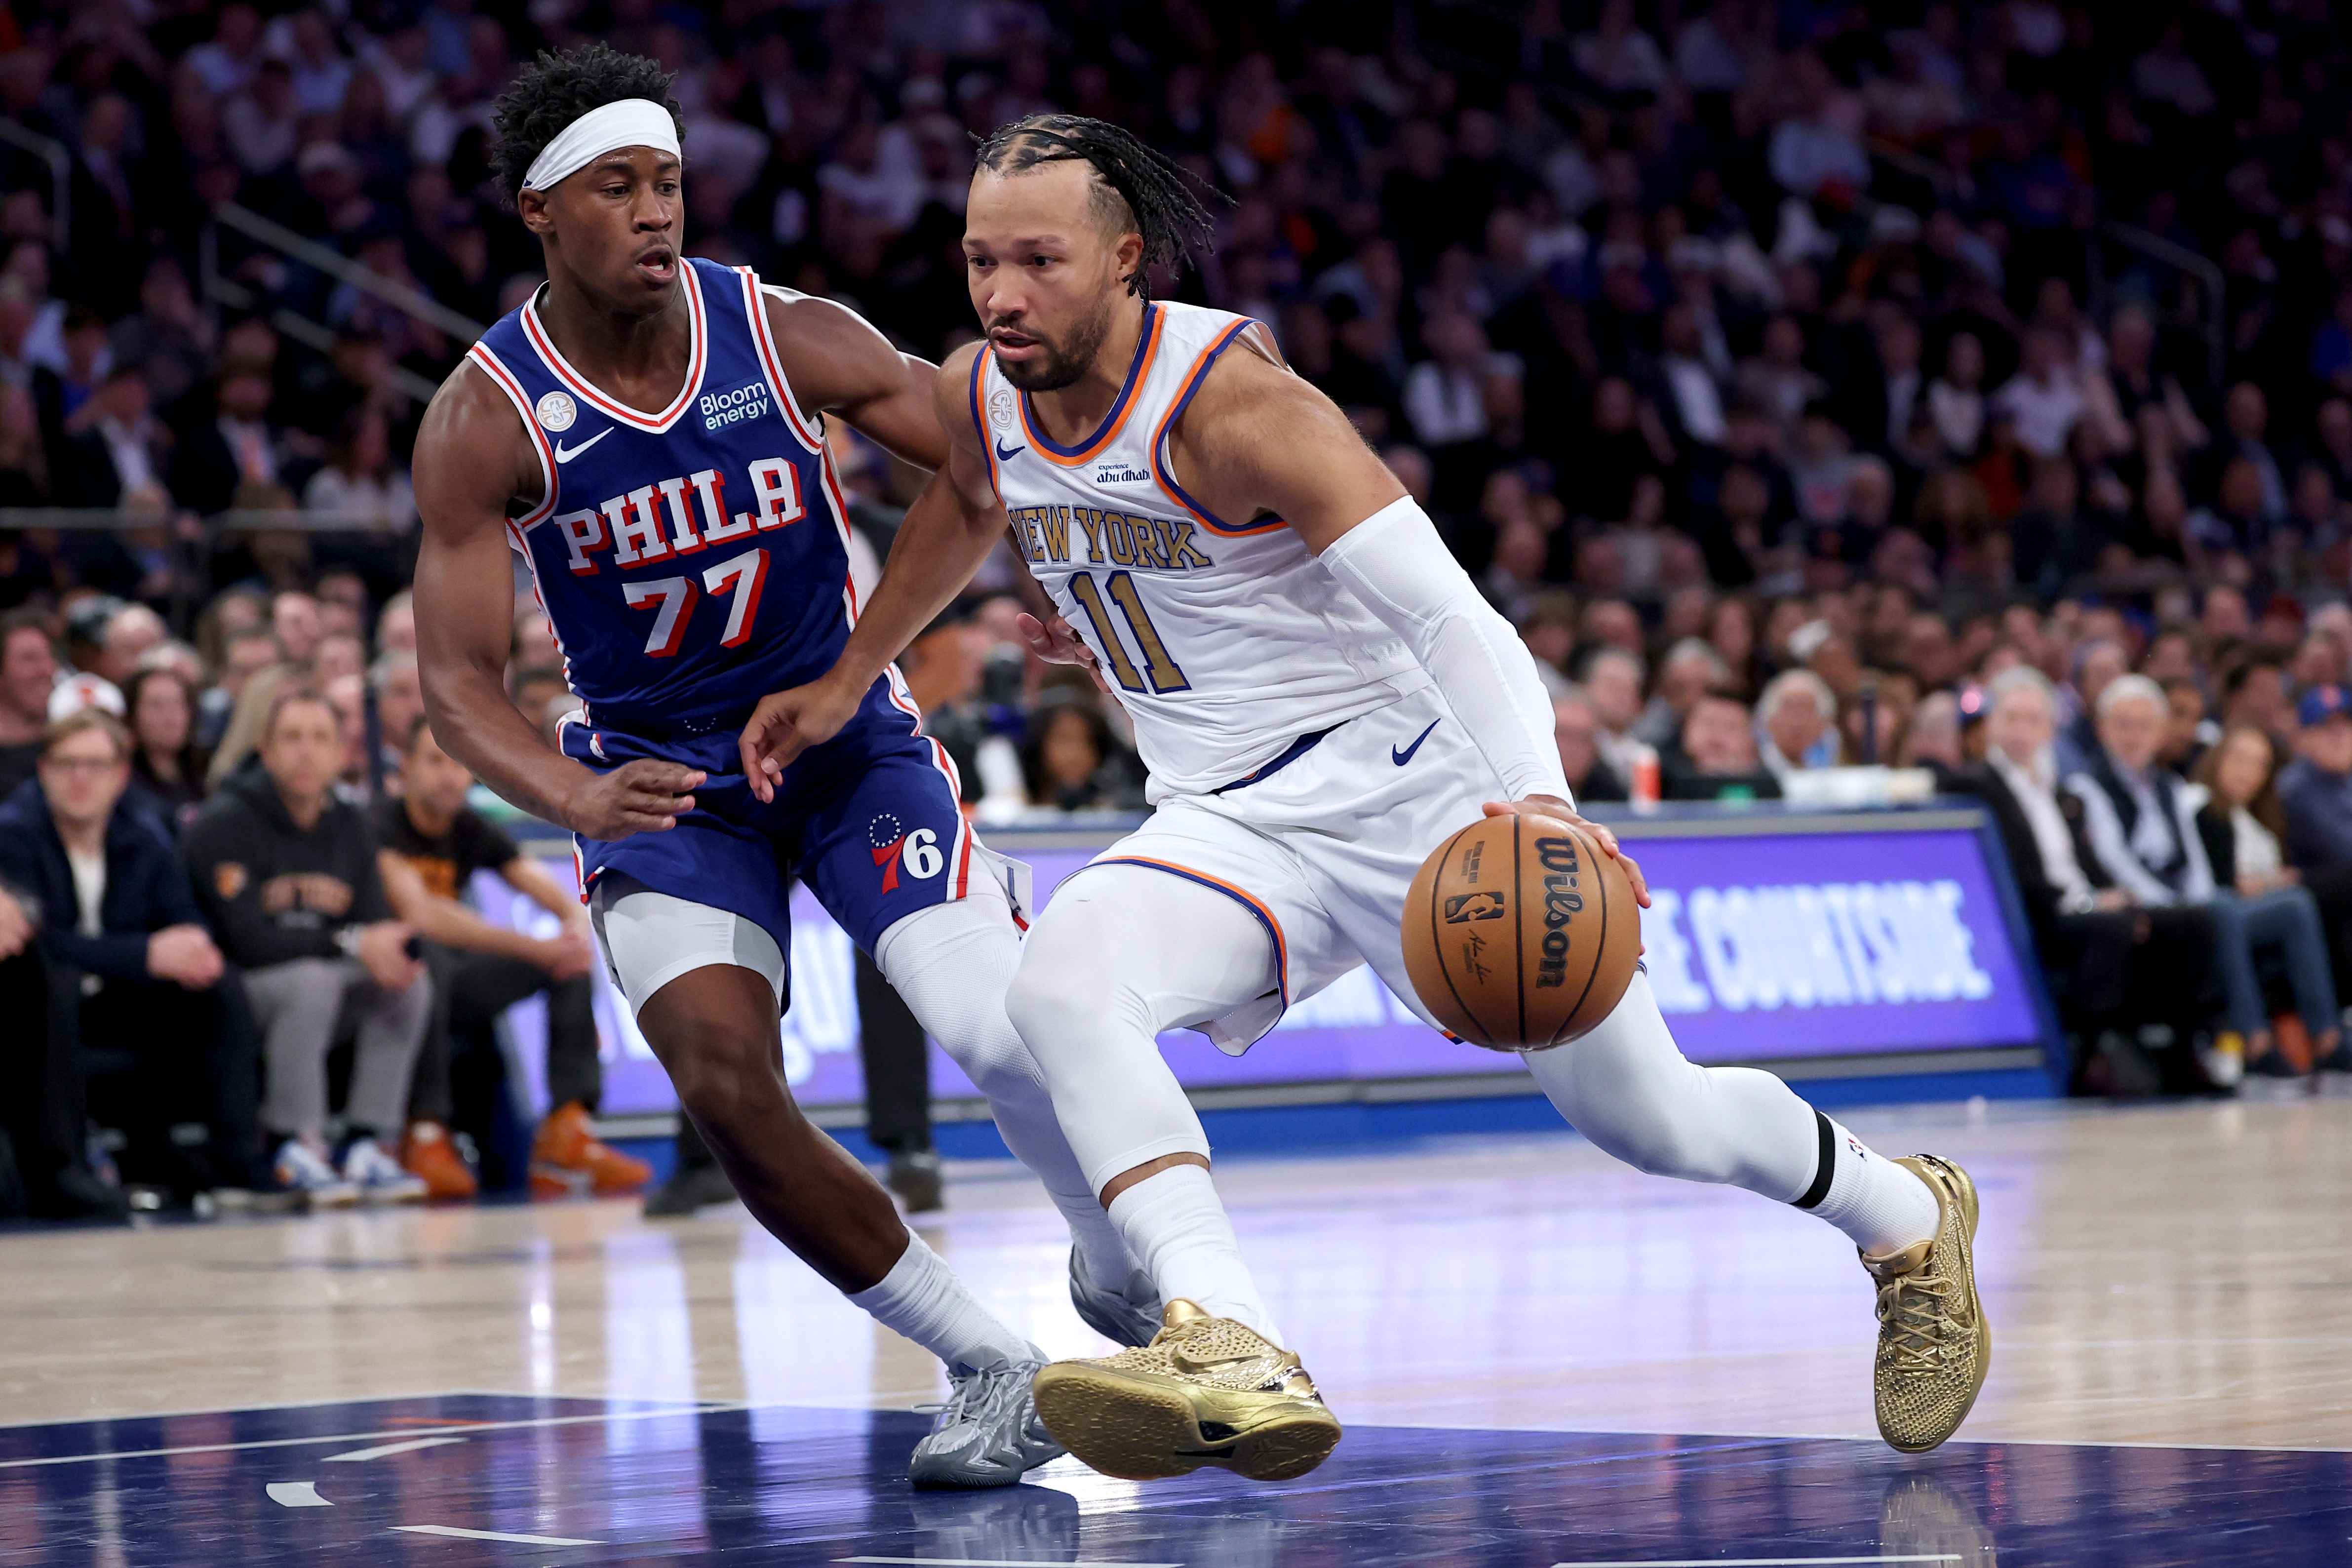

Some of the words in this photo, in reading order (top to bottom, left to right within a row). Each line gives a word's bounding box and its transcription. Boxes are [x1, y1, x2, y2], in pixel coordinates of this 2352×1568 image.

[700, 382, 766, 415] Bloom
[706, 397, 768, 430] energy
[1097, 471, 1119, 483] abu
[1121, 468, 1150, 481] dhabi
[553, 457, 807, 576] PHILA
[1008, 506, 1070, 562] NEW
[1074, 507, 1213, 568] YORK
[622, 548, 770, 658] 77
[1067, 570, 1192, 695] 11
[871, 828, 943, 895] 76
[1534, 837, 1584, 989] Wilson
